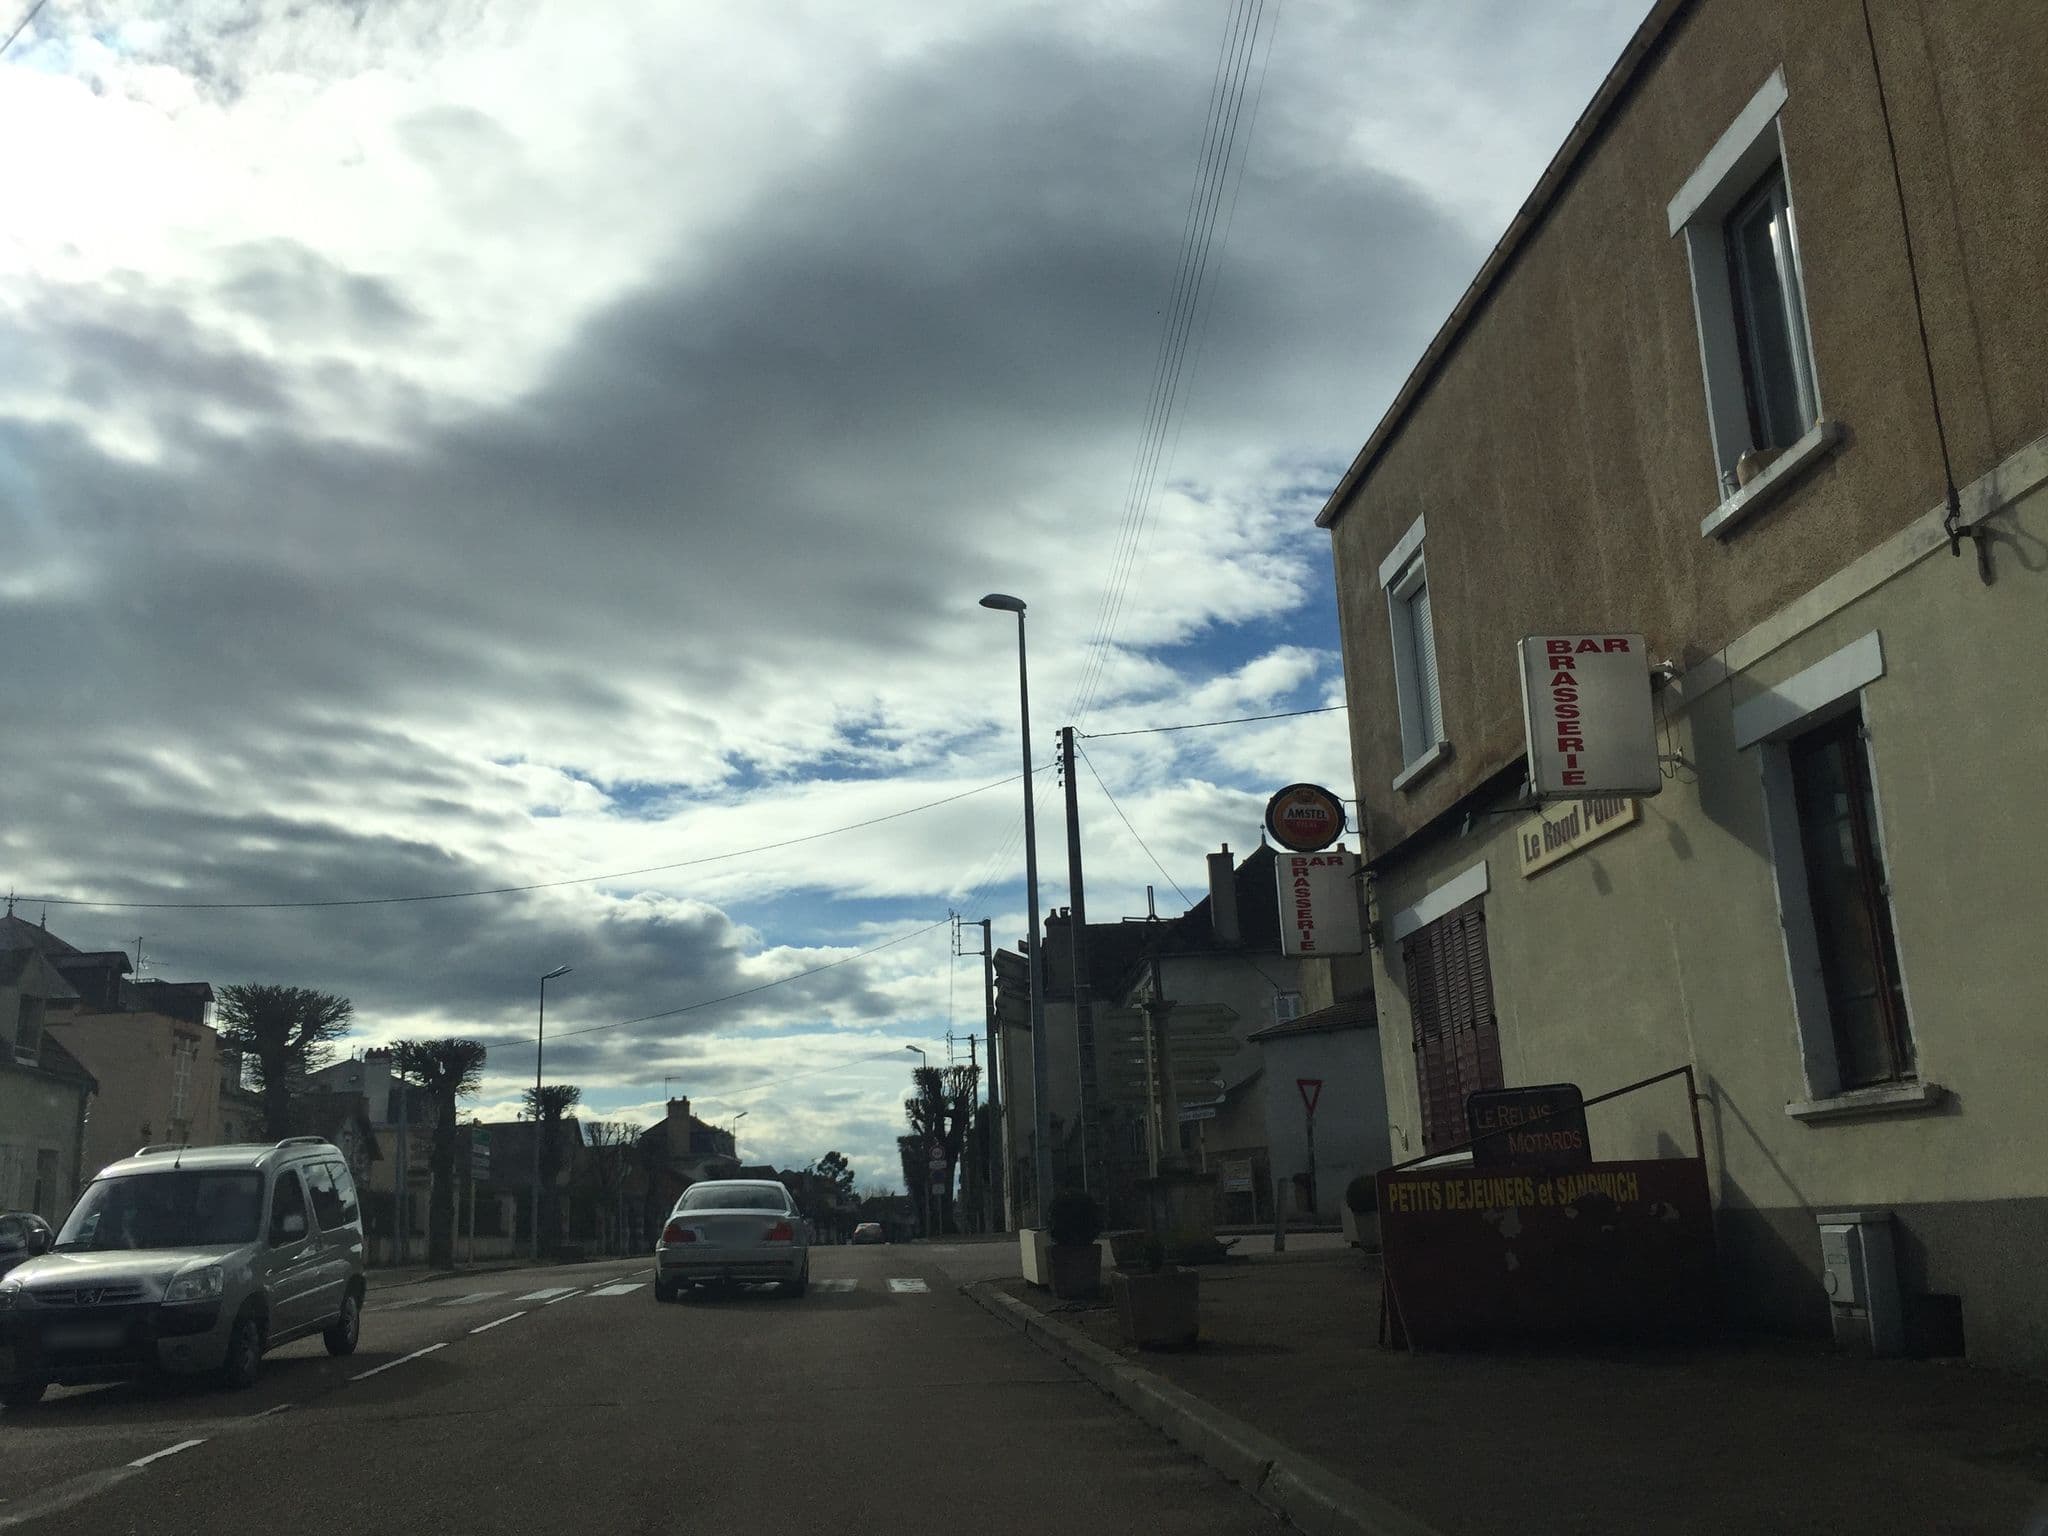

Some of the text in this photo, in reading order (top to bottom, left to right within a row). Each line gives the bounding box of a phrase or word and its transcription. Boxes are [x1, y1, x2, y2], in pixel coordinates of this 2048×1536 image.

[1546, 638, 1630, 654] BAR
[1287, 807, 1328, 820] AMSTEL
[1523, 833, 1541, 863] Le
[1542, 804, 1580, 853] Rond
[1291, 856, 1344, 867] BAR
[1507, 1129, 1582, 1153] MOTARDS
[1388, 1171, 1640, 1213] PETITS DEJEUNERS et SANDWICH
